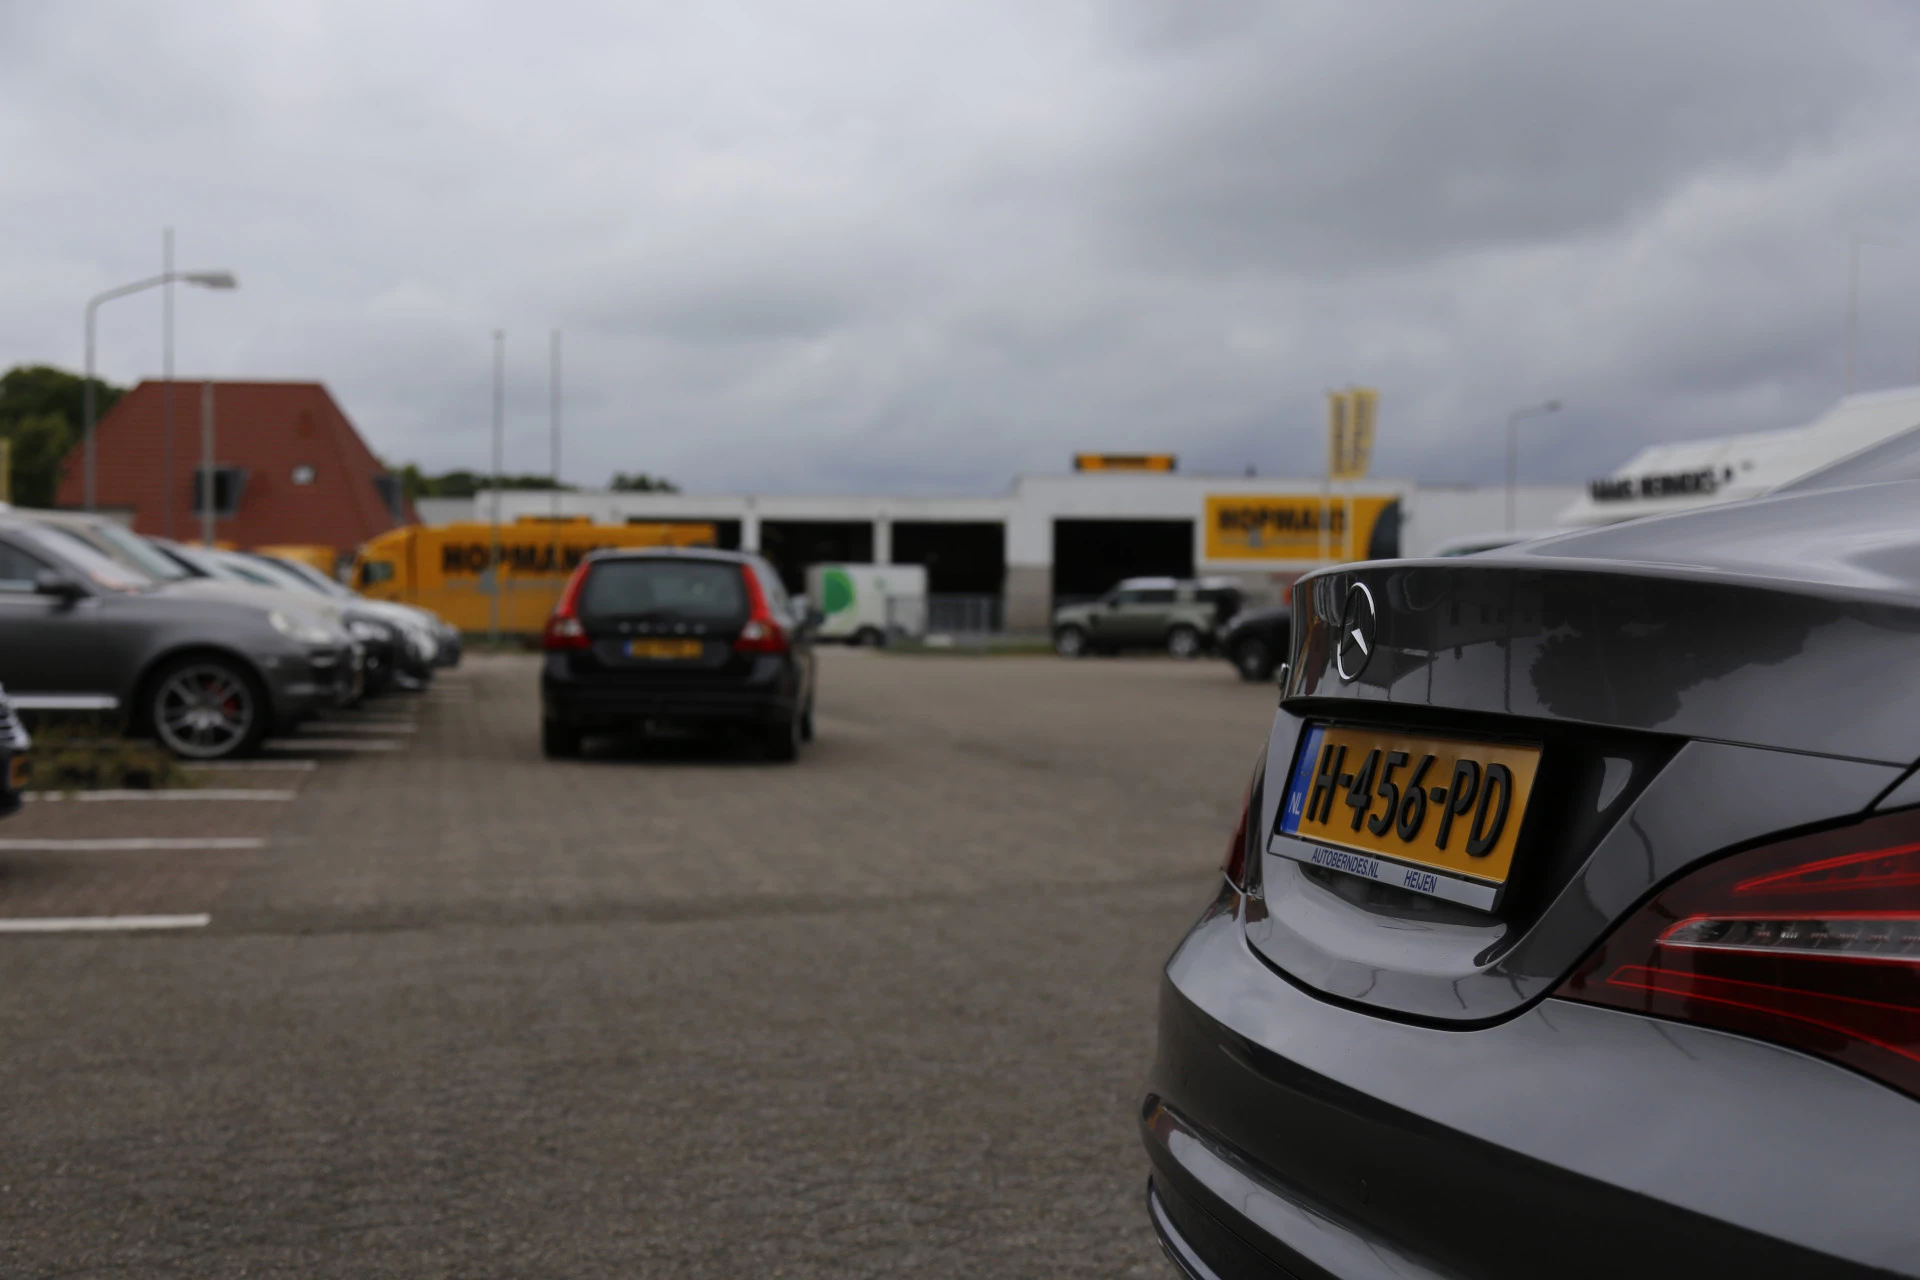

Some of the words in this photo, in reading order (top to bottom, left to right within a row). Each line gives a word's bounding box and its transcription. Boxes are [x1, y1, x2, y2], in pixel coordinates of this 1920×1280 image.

[1288, 792, 1301, 816] NL
[1305, 744, 1513, 858] H-456-PD
[1311, 847, 1379, 879] AUTOBERNDES.NL
[1403, 869, 1438, 893] HEIJEN
